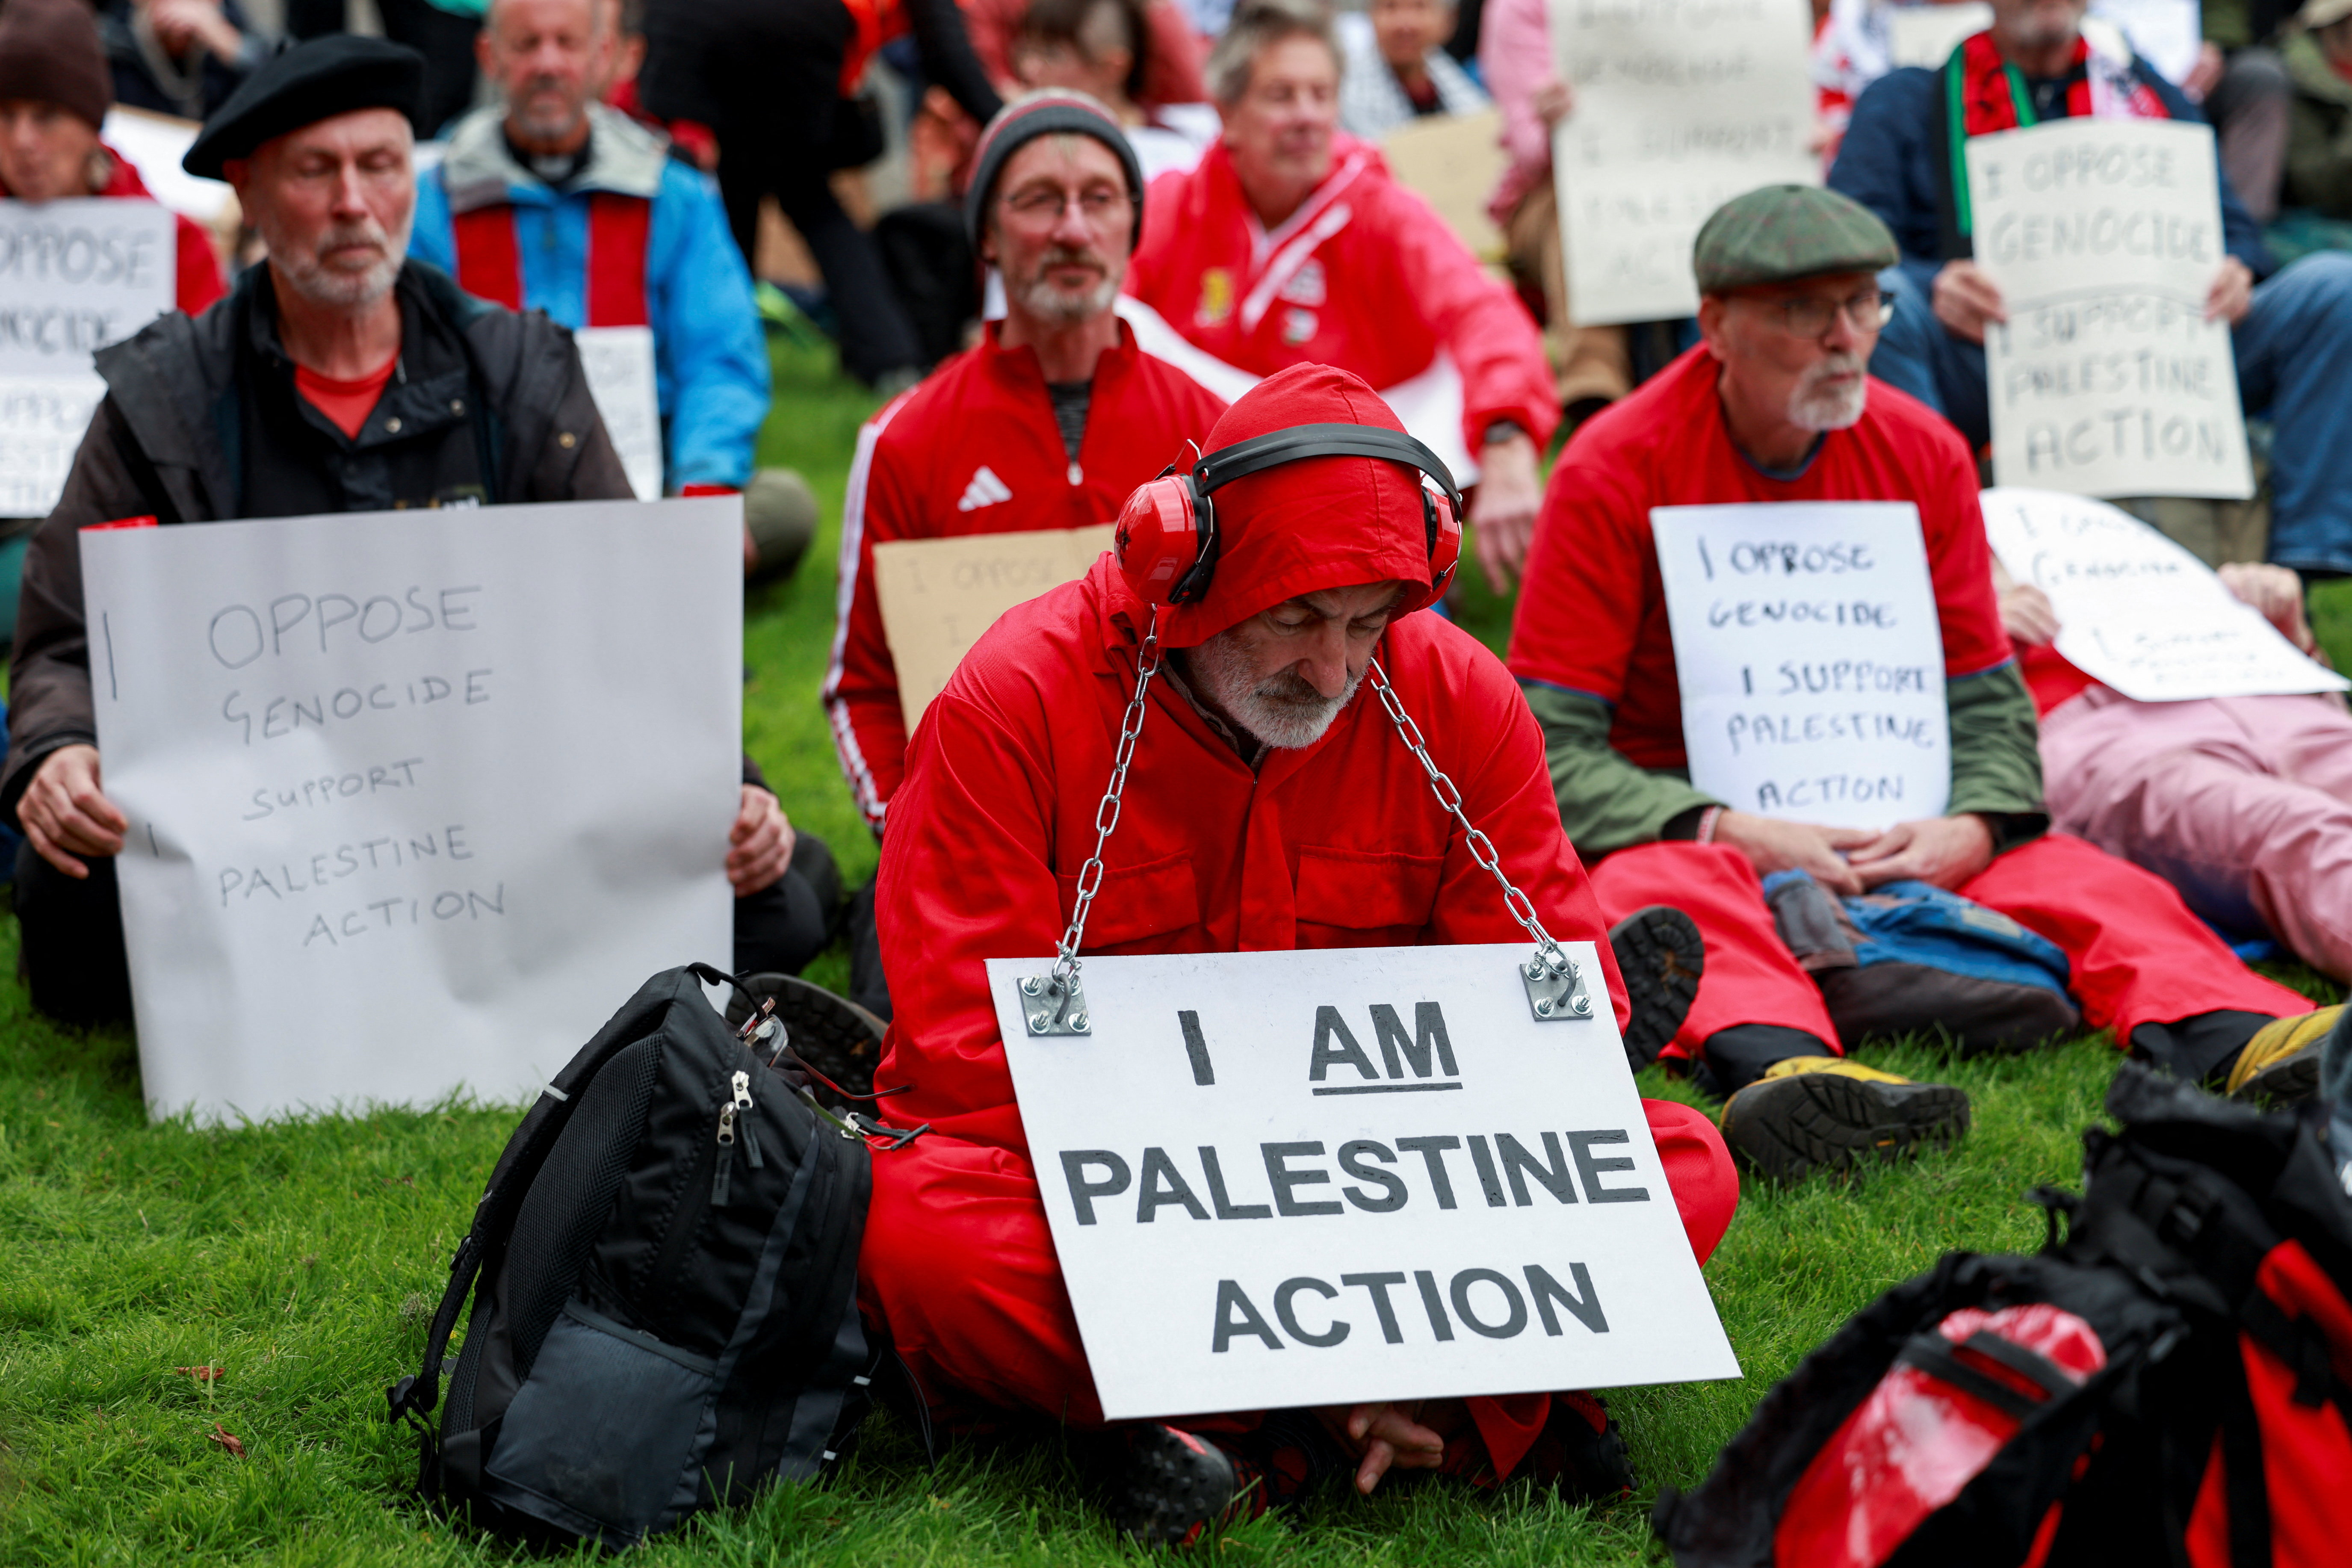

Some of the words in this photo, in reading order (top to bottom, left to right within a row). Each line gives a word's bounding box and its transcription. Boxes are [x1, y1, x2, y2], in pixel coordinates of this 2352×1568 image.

[1983, 160, 2005, 200] I
[2021, 142, 2177, 192] OPPOSE
[1988, 207, 2216, 266] GENOCIDE
[2004, 347, 2215, 409] PALESTINE
[2025, 407, 2225, 473] ACTION
[905, 557, 929, 594] I
[1696, 534, 1715, 582] I
[103, 610, 117, 702] I
[208, 585, 483, 670] OPPOSE
[1708, 599, 1898, 629] GENOCIDE
[222, 668, 494, 746] GENOCIDE
[1741, 664, 1753, 697] I
[1778, 659, 1935, 697] SUPPORT
[1726, 711, 1935, 756] PALESTINE
[242, 756, 425, 821] SUPPORT
[1756, 774, 1905, 811] ACTION
[218, 824, 475, 907] PALESTINE
[302, 882, 505, 948] ACTION
[1177, 1010, 1215, 1086] I
[1309, 1001, 1459, 1082] AM
[1059, 1128, 1650, 1225] PALESTINE
[1212, 1262, 1610, 1353] ACTION
